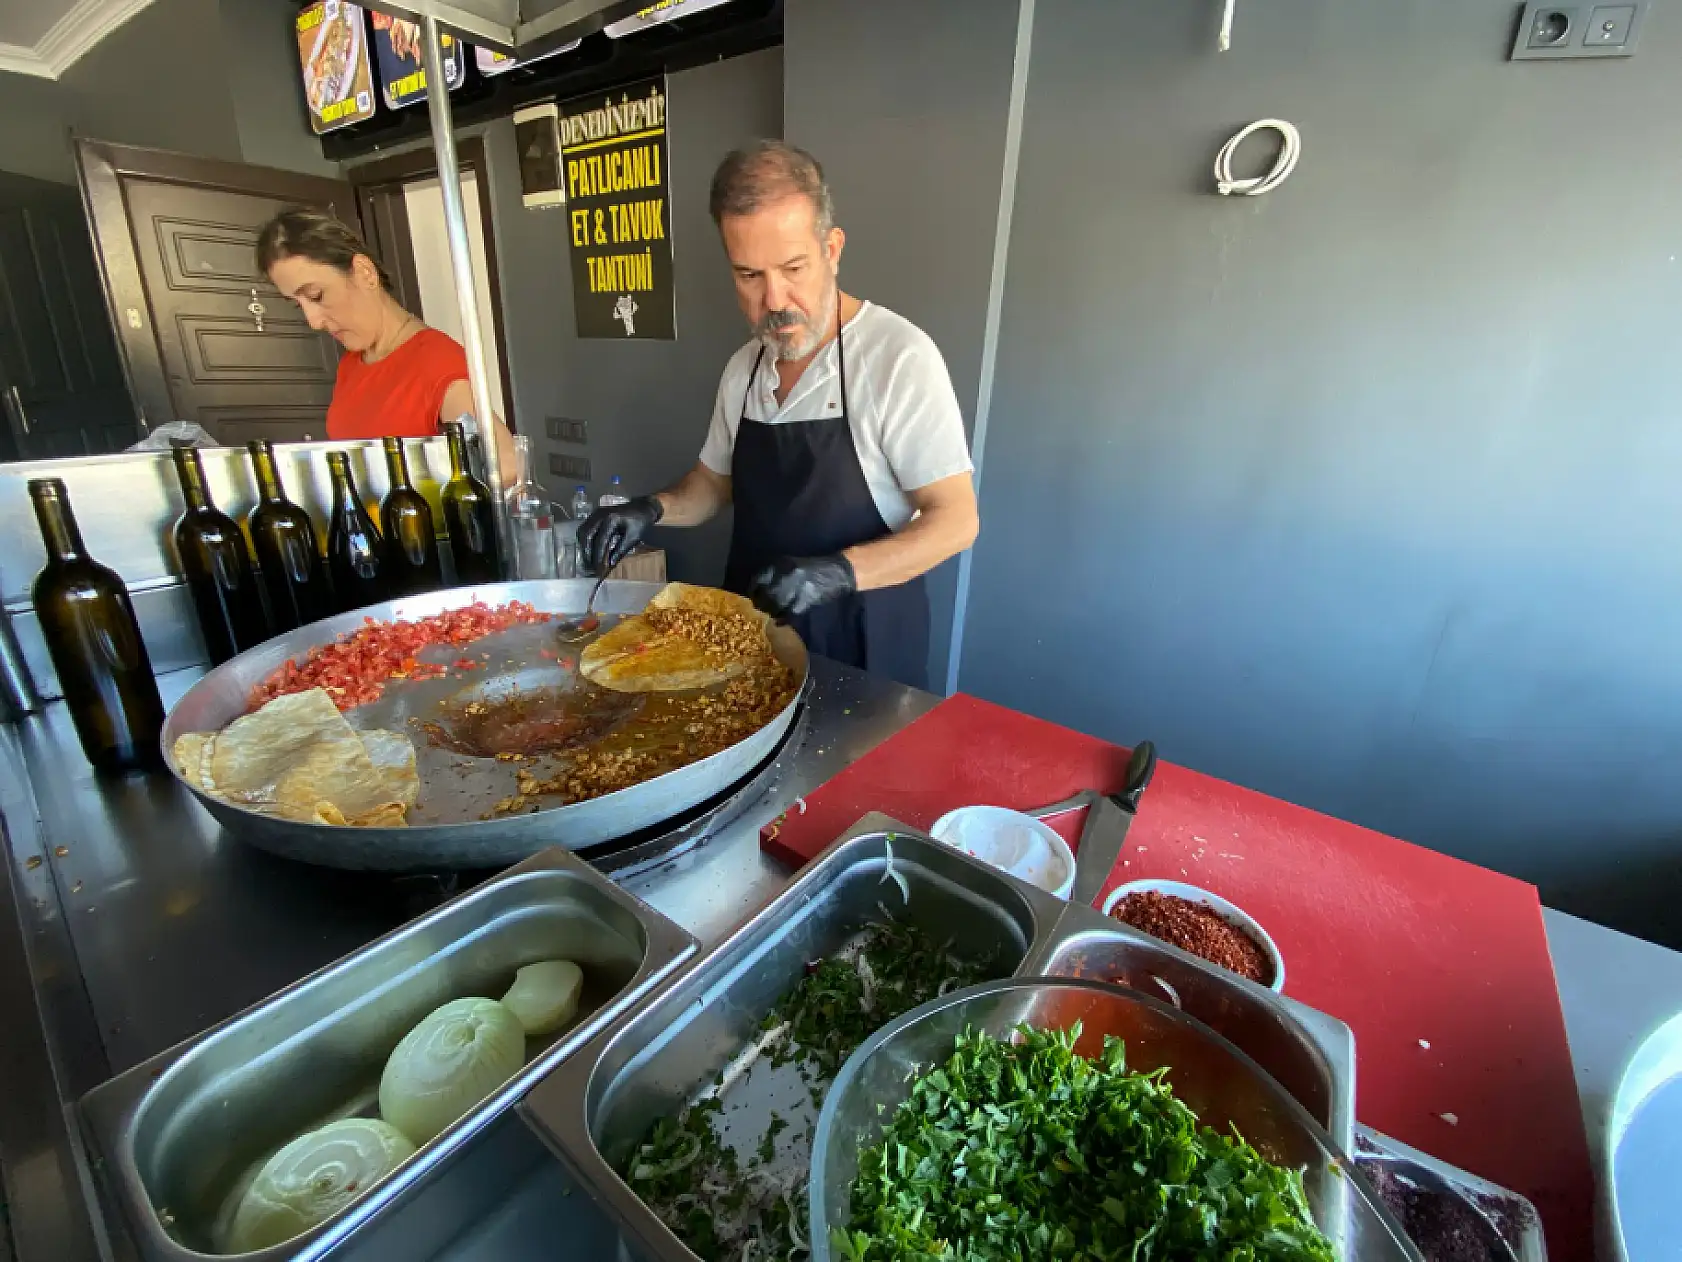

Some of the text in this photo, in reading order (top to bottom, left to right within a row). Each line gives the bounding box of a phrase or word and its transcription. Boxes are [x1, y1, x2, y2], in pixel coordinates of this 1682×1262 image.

[568, 145, 661, 198] PATLICANLI
[571, 199, 665, 247] ET & TAVUK
[586, 246, 653, 293] TANTUNİ
